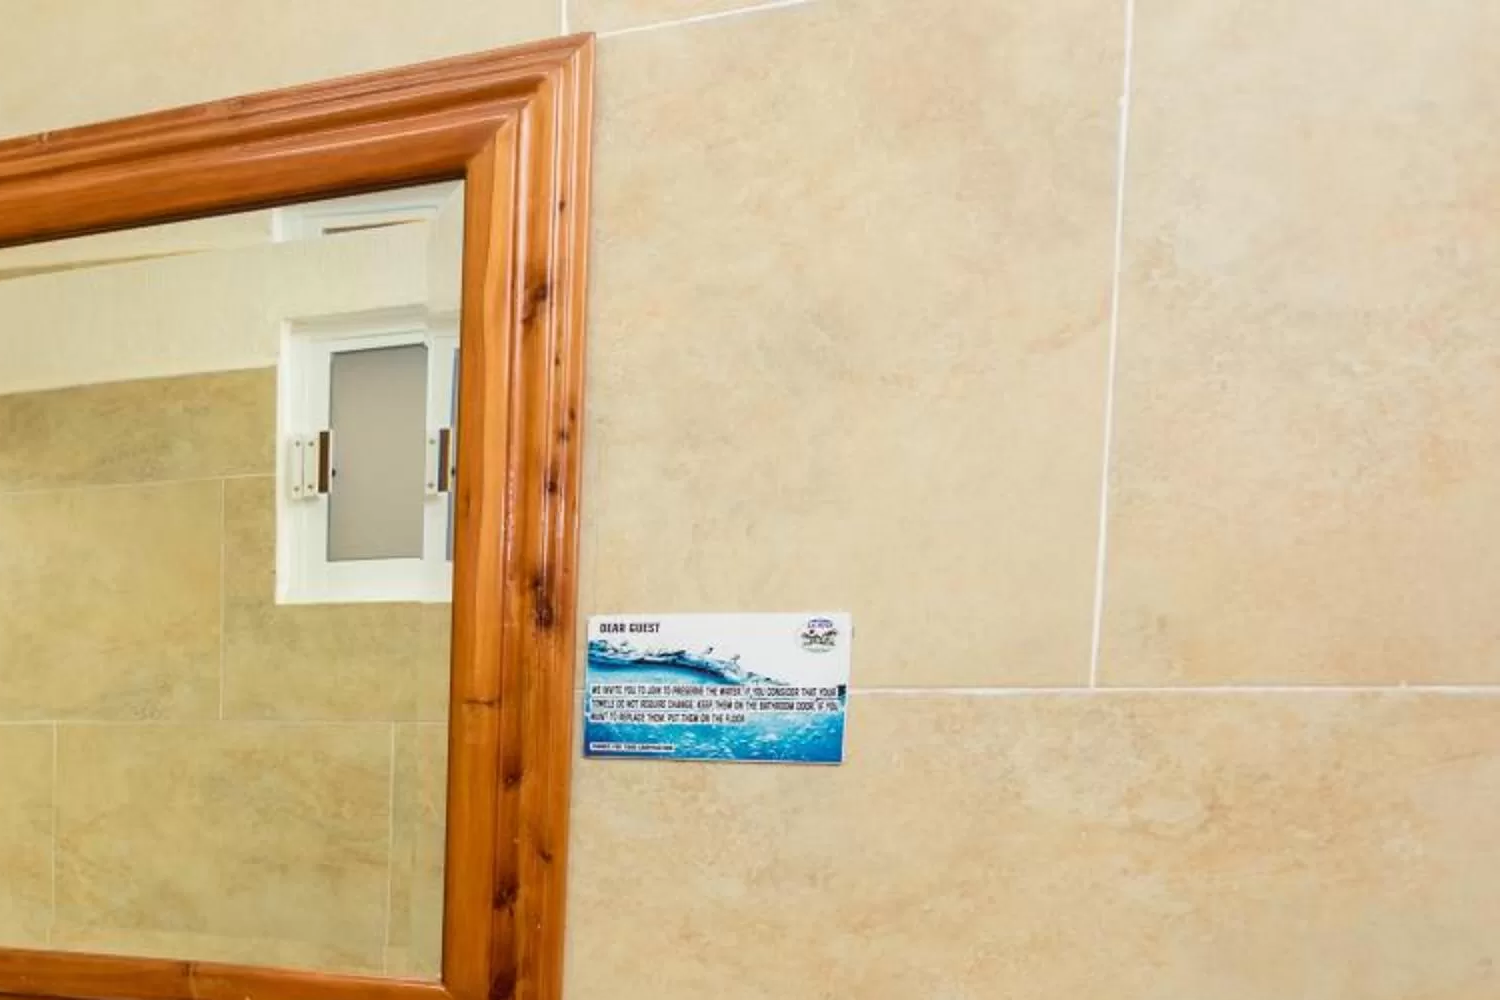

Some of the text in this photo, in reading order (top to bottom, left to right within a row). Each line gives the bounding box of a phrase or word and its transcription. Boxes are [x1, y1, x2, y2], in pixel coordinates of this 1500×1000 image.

[599, 623, 660, 633] DEAR GUEST
[624, 686, 636, 695] YOU
[706, 686, 717, 695] THE
[767, 687, 799, 696] CONSIDER
[801, 687, 817, 696] THAT
[819, 687, 837, 696] YOUR
[626, 700, 638, 709] NOT
[746, 701, 757, 710] THE
[759, 701, 794, 710] BATHROOM
[712, 714, 723, 723] THE
